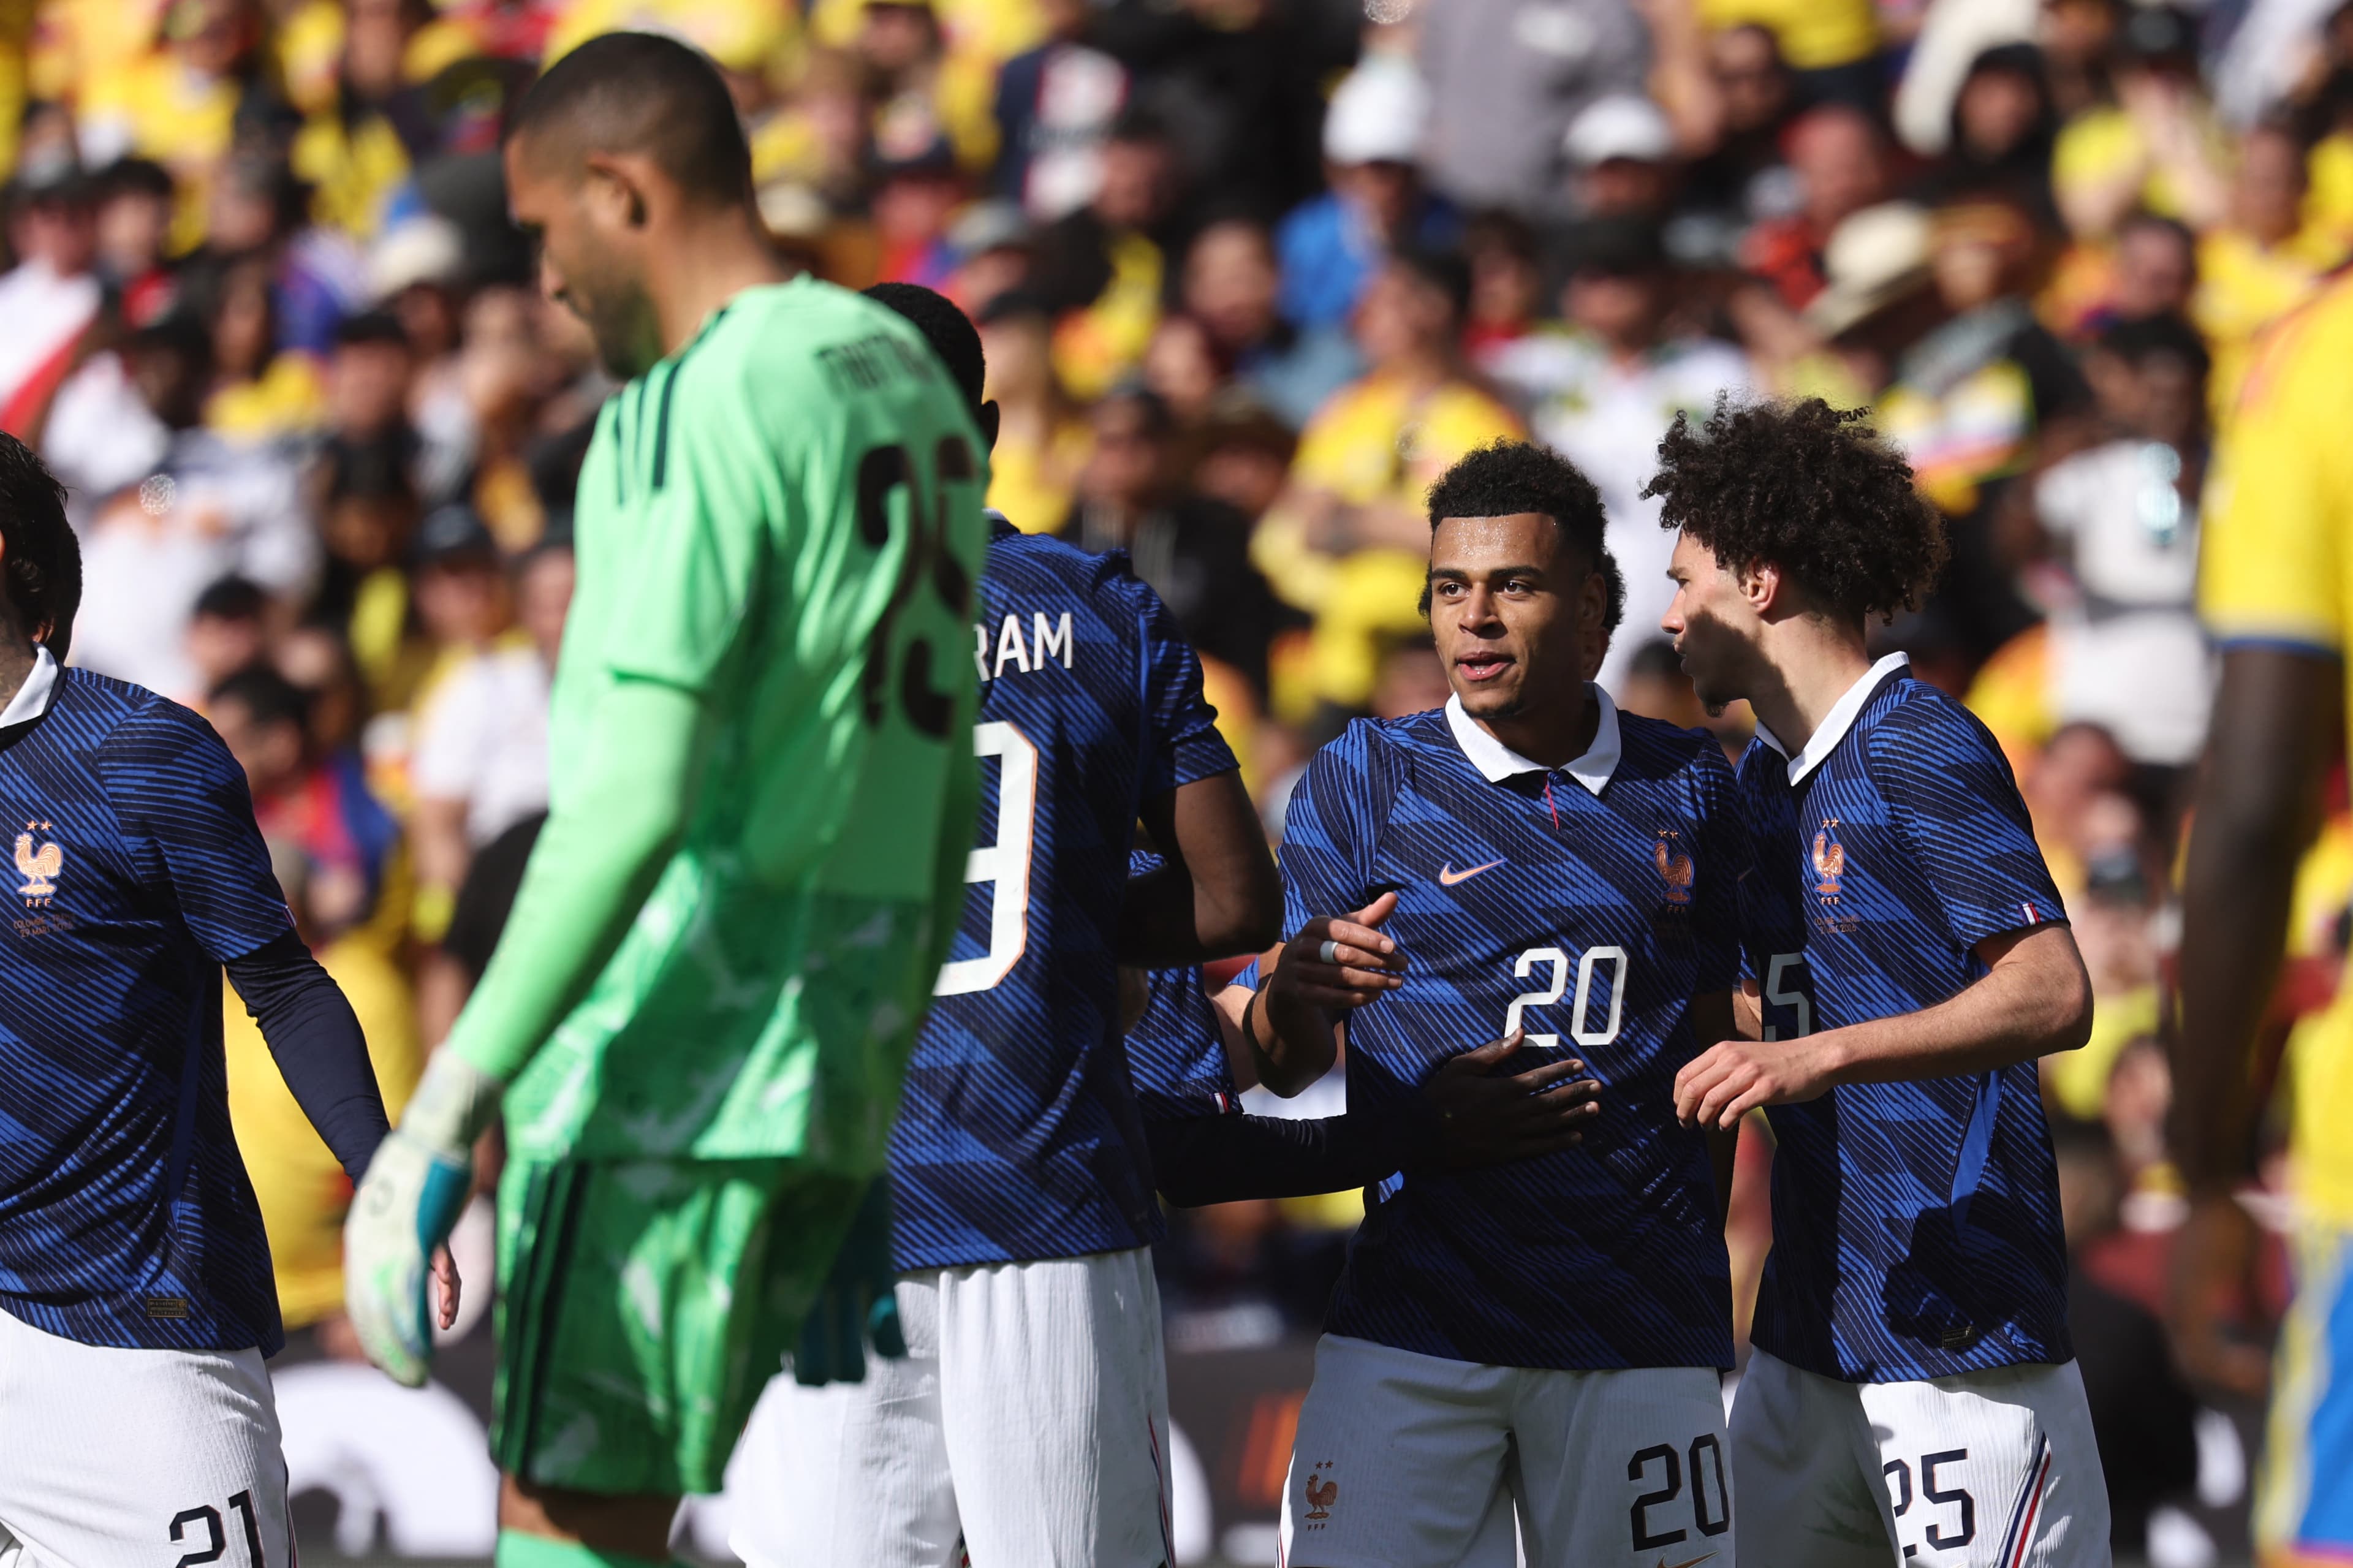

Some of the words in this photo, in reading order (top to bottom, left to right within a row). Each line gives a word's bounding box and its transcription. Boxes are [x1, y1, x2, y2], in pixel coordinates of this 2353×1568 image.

[26, 898, 52, 907] FFF
[1667, 904, 1686, 914] FFF
[1821, 896, 1840, 906] FFF
[1504, 946, 1627, 1047] 20
[1754, 952, 1810, 1042] 5
[169, 1489, 266, 1568] 21
[1627, 1433, 1730, 1551] 20
[1883, 1448, 1976, 1558] 25
